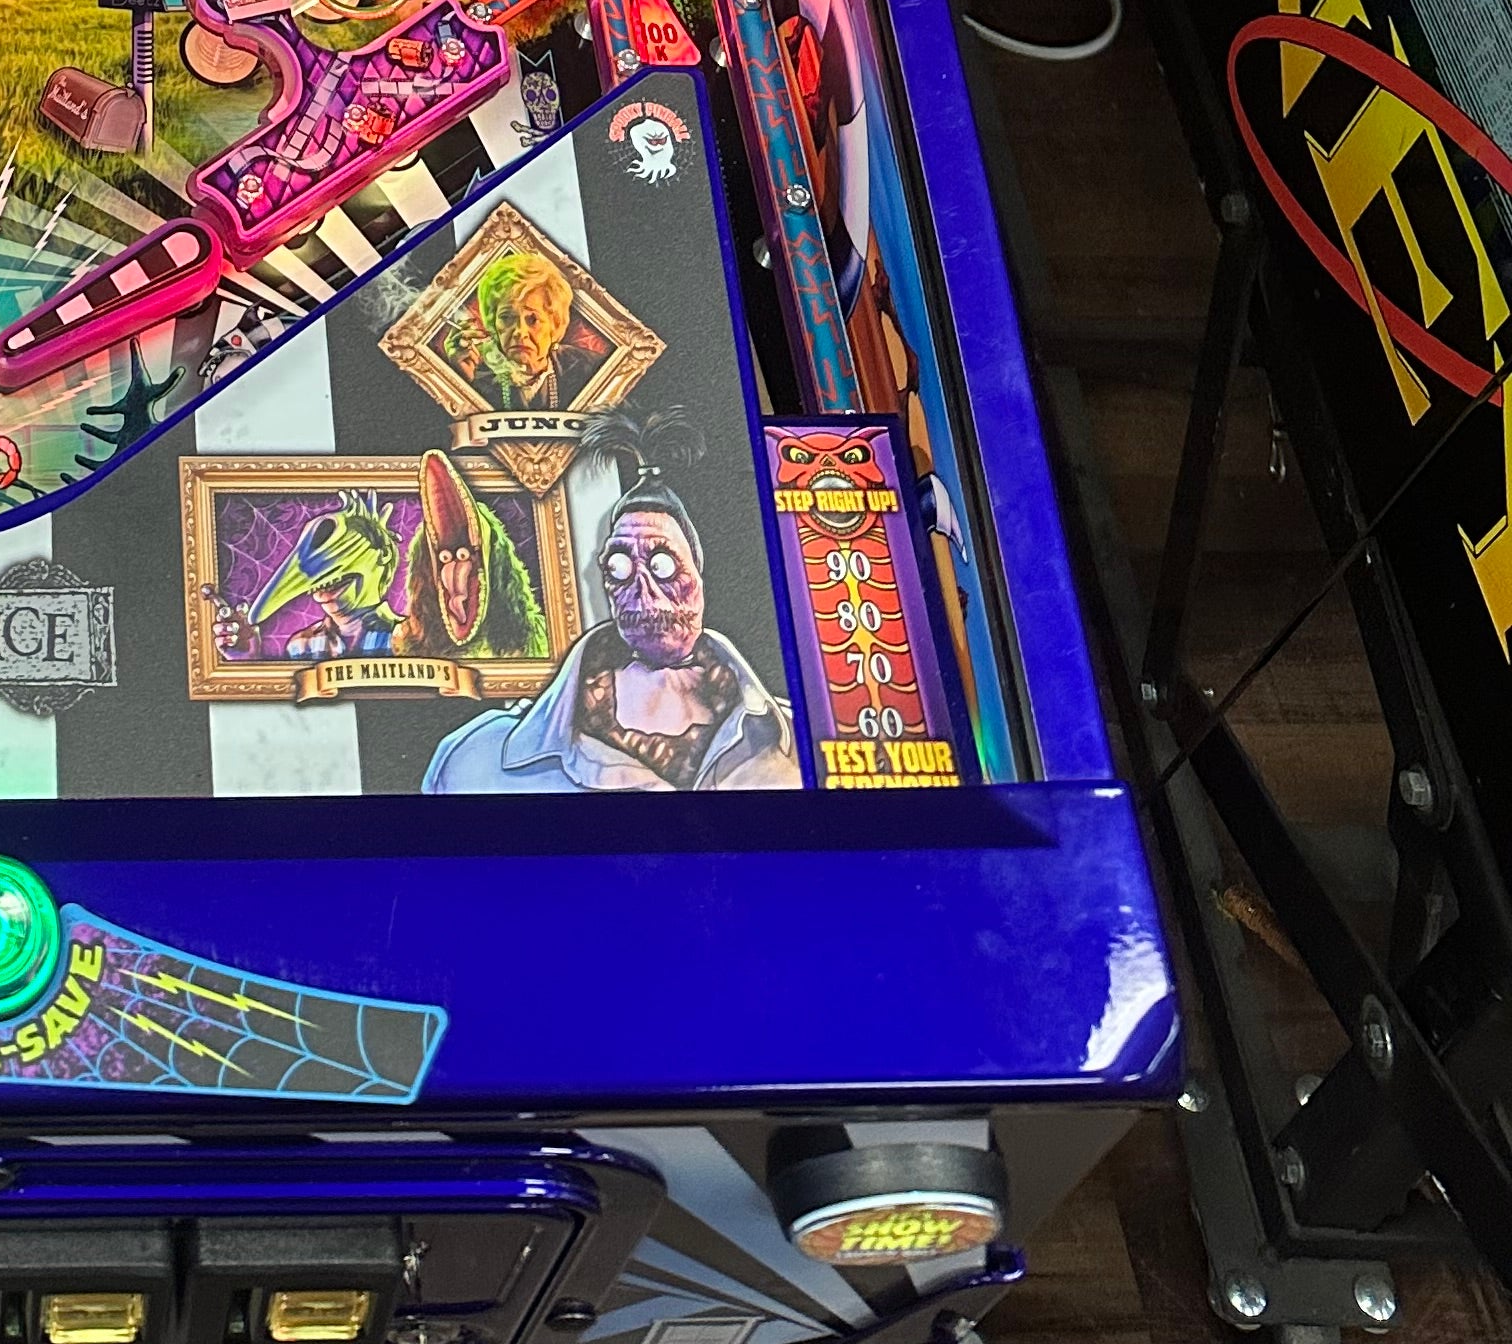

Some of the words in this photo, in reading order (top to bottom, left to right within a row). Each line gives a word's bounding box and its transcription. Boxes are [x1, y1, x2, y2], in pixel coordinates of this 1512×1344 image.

[640, 23, 679, 44] 100
[479, 416, 585, 433] JUNO
[773, 489, 814, 513] STEP
[814, 489, 866, 513] RIGHT
[867, 489, 899, 513] UP!
[825, 549, 872, 582] 90
[837, 600, 882, 633] 80
[324, 664, 355, 683] THE
[359, 662, 452, 684] MAITLAND'S
[846, 652, 893, 685] 70
[858, 706, 903, 739] 60
[819, 740, 879, 774] TEST
[884, 740, 955, 773] YOUR
[844, 1217, 964, 1237] SHOW
